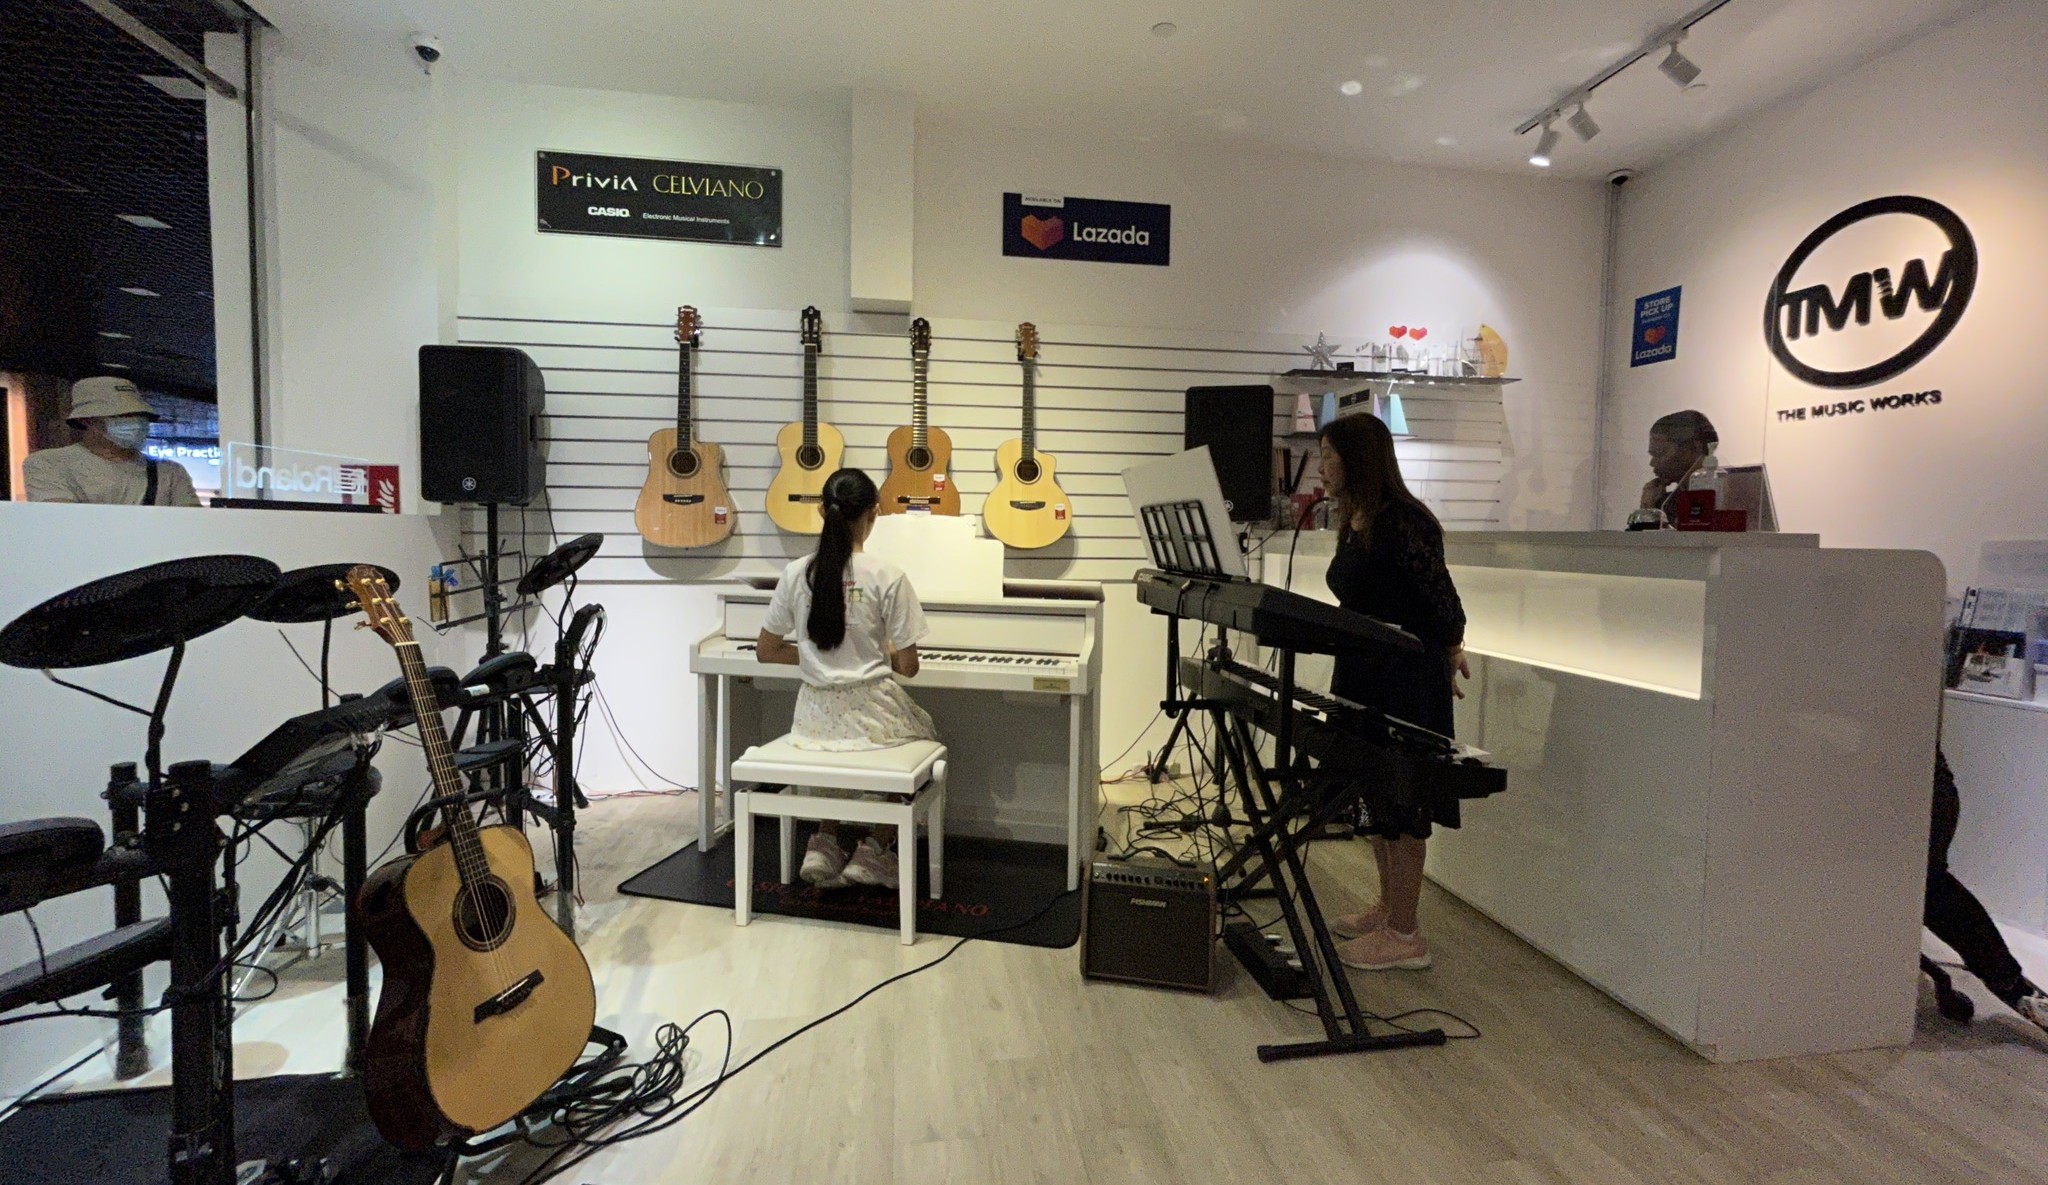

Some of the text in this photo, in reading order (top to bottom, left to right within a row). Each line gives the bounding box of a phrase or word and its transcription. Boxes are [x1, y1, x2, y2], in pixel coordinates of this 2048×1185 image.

[652, 174, 764, 199] CELVIANO
[588, 206, 630, 217] CASIO
[642, 212, 671, 220] Electronic
[696, 216, 730, 224] Instruments
[1073, 222, 1150, 246] Lazada
[1777, 249, 1957, 341] TMW
[1640, 307, 1660, 318] PICK
[1661, 303, 1673, 312] UP
[1644, 296, 1671, 310] STORE
[1635, 344, 1672, 359] Lazada
[1777, 390, 1942, 422] THE MUSIC WORKS
[148, 445, 174, 458] Eye
